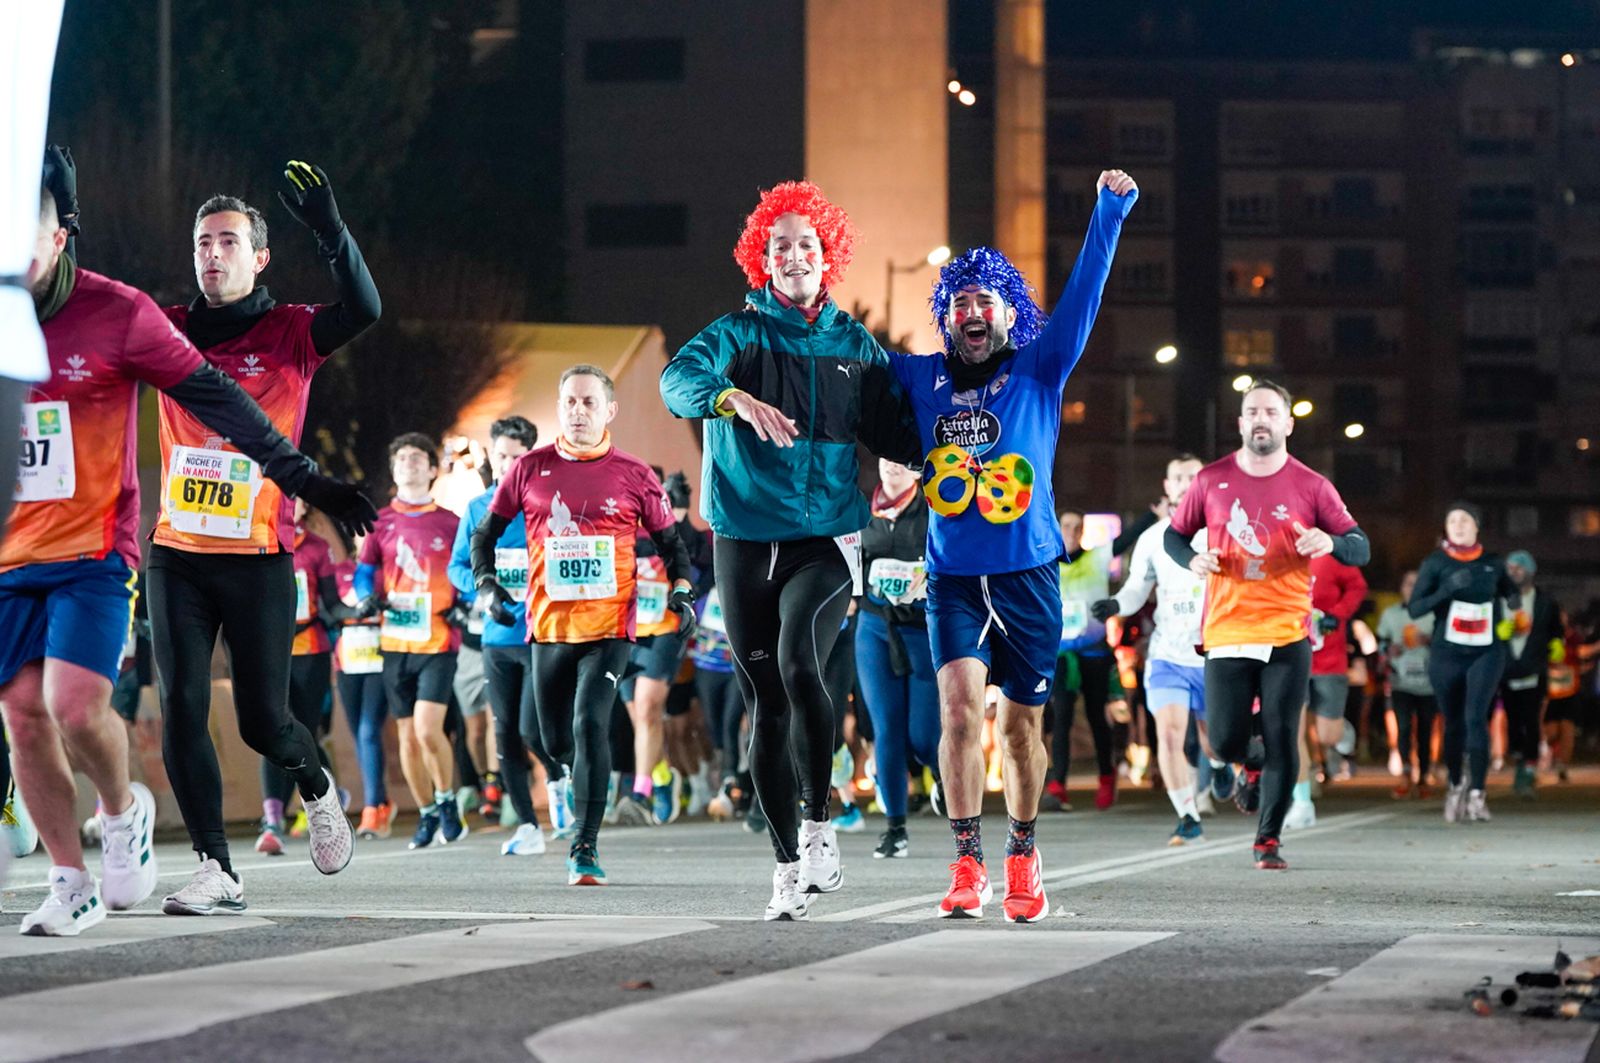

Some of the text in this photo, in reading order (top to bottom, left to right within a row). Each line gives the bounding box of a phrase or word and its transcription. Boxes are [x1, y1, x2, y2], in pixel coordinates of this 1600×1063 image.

[941, 417, 989, 432] Estrella
[943, 431, 989, 446] Galicia
[186, 457, 210, 468] NOCHE
[211, 459, 223, 468] DE
[183, 478, 233, 507] 6778
[844, 535, 856, 545] SAN
